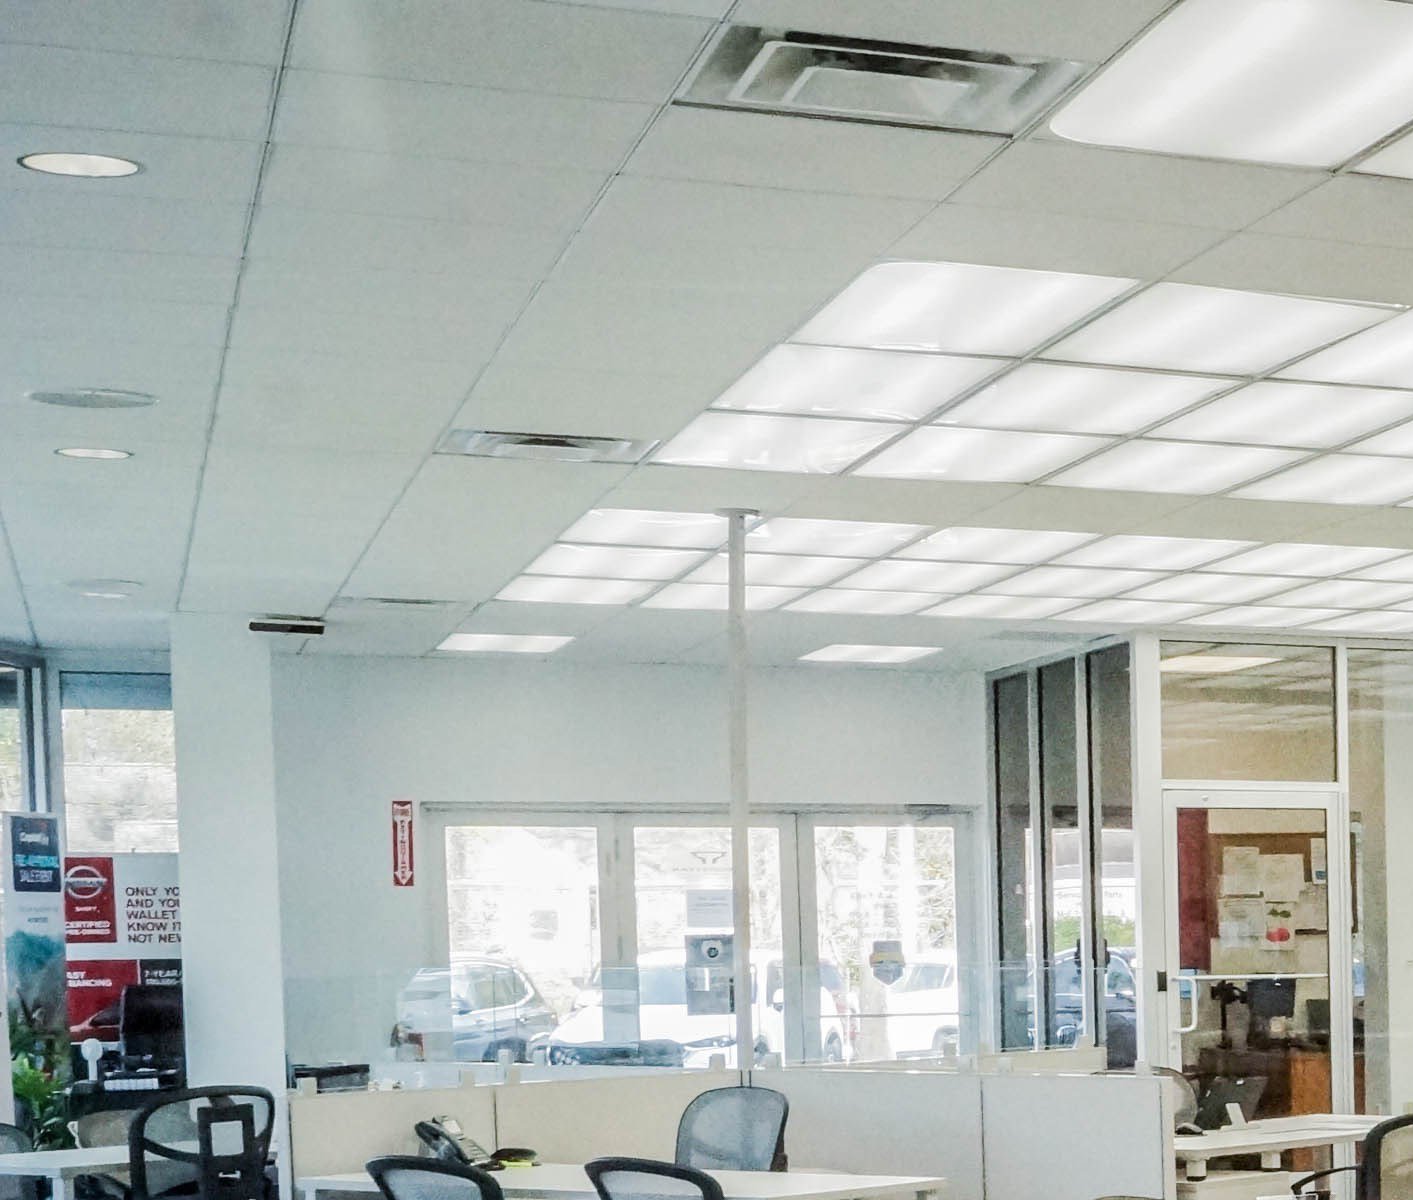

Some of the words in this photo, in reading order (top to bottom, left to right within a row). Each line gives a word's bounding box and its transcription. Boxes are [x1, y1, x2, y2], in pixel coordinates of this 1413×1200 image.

[126, 887, 158, 896] ONLY
[164, 886, 180, 896] YO
[127, 898, 154, 908] AND
[127, 910, 177, 920] WALLET
[127, 921, 168, 931] KNOW
[128, 933, 153, 943] NOT
